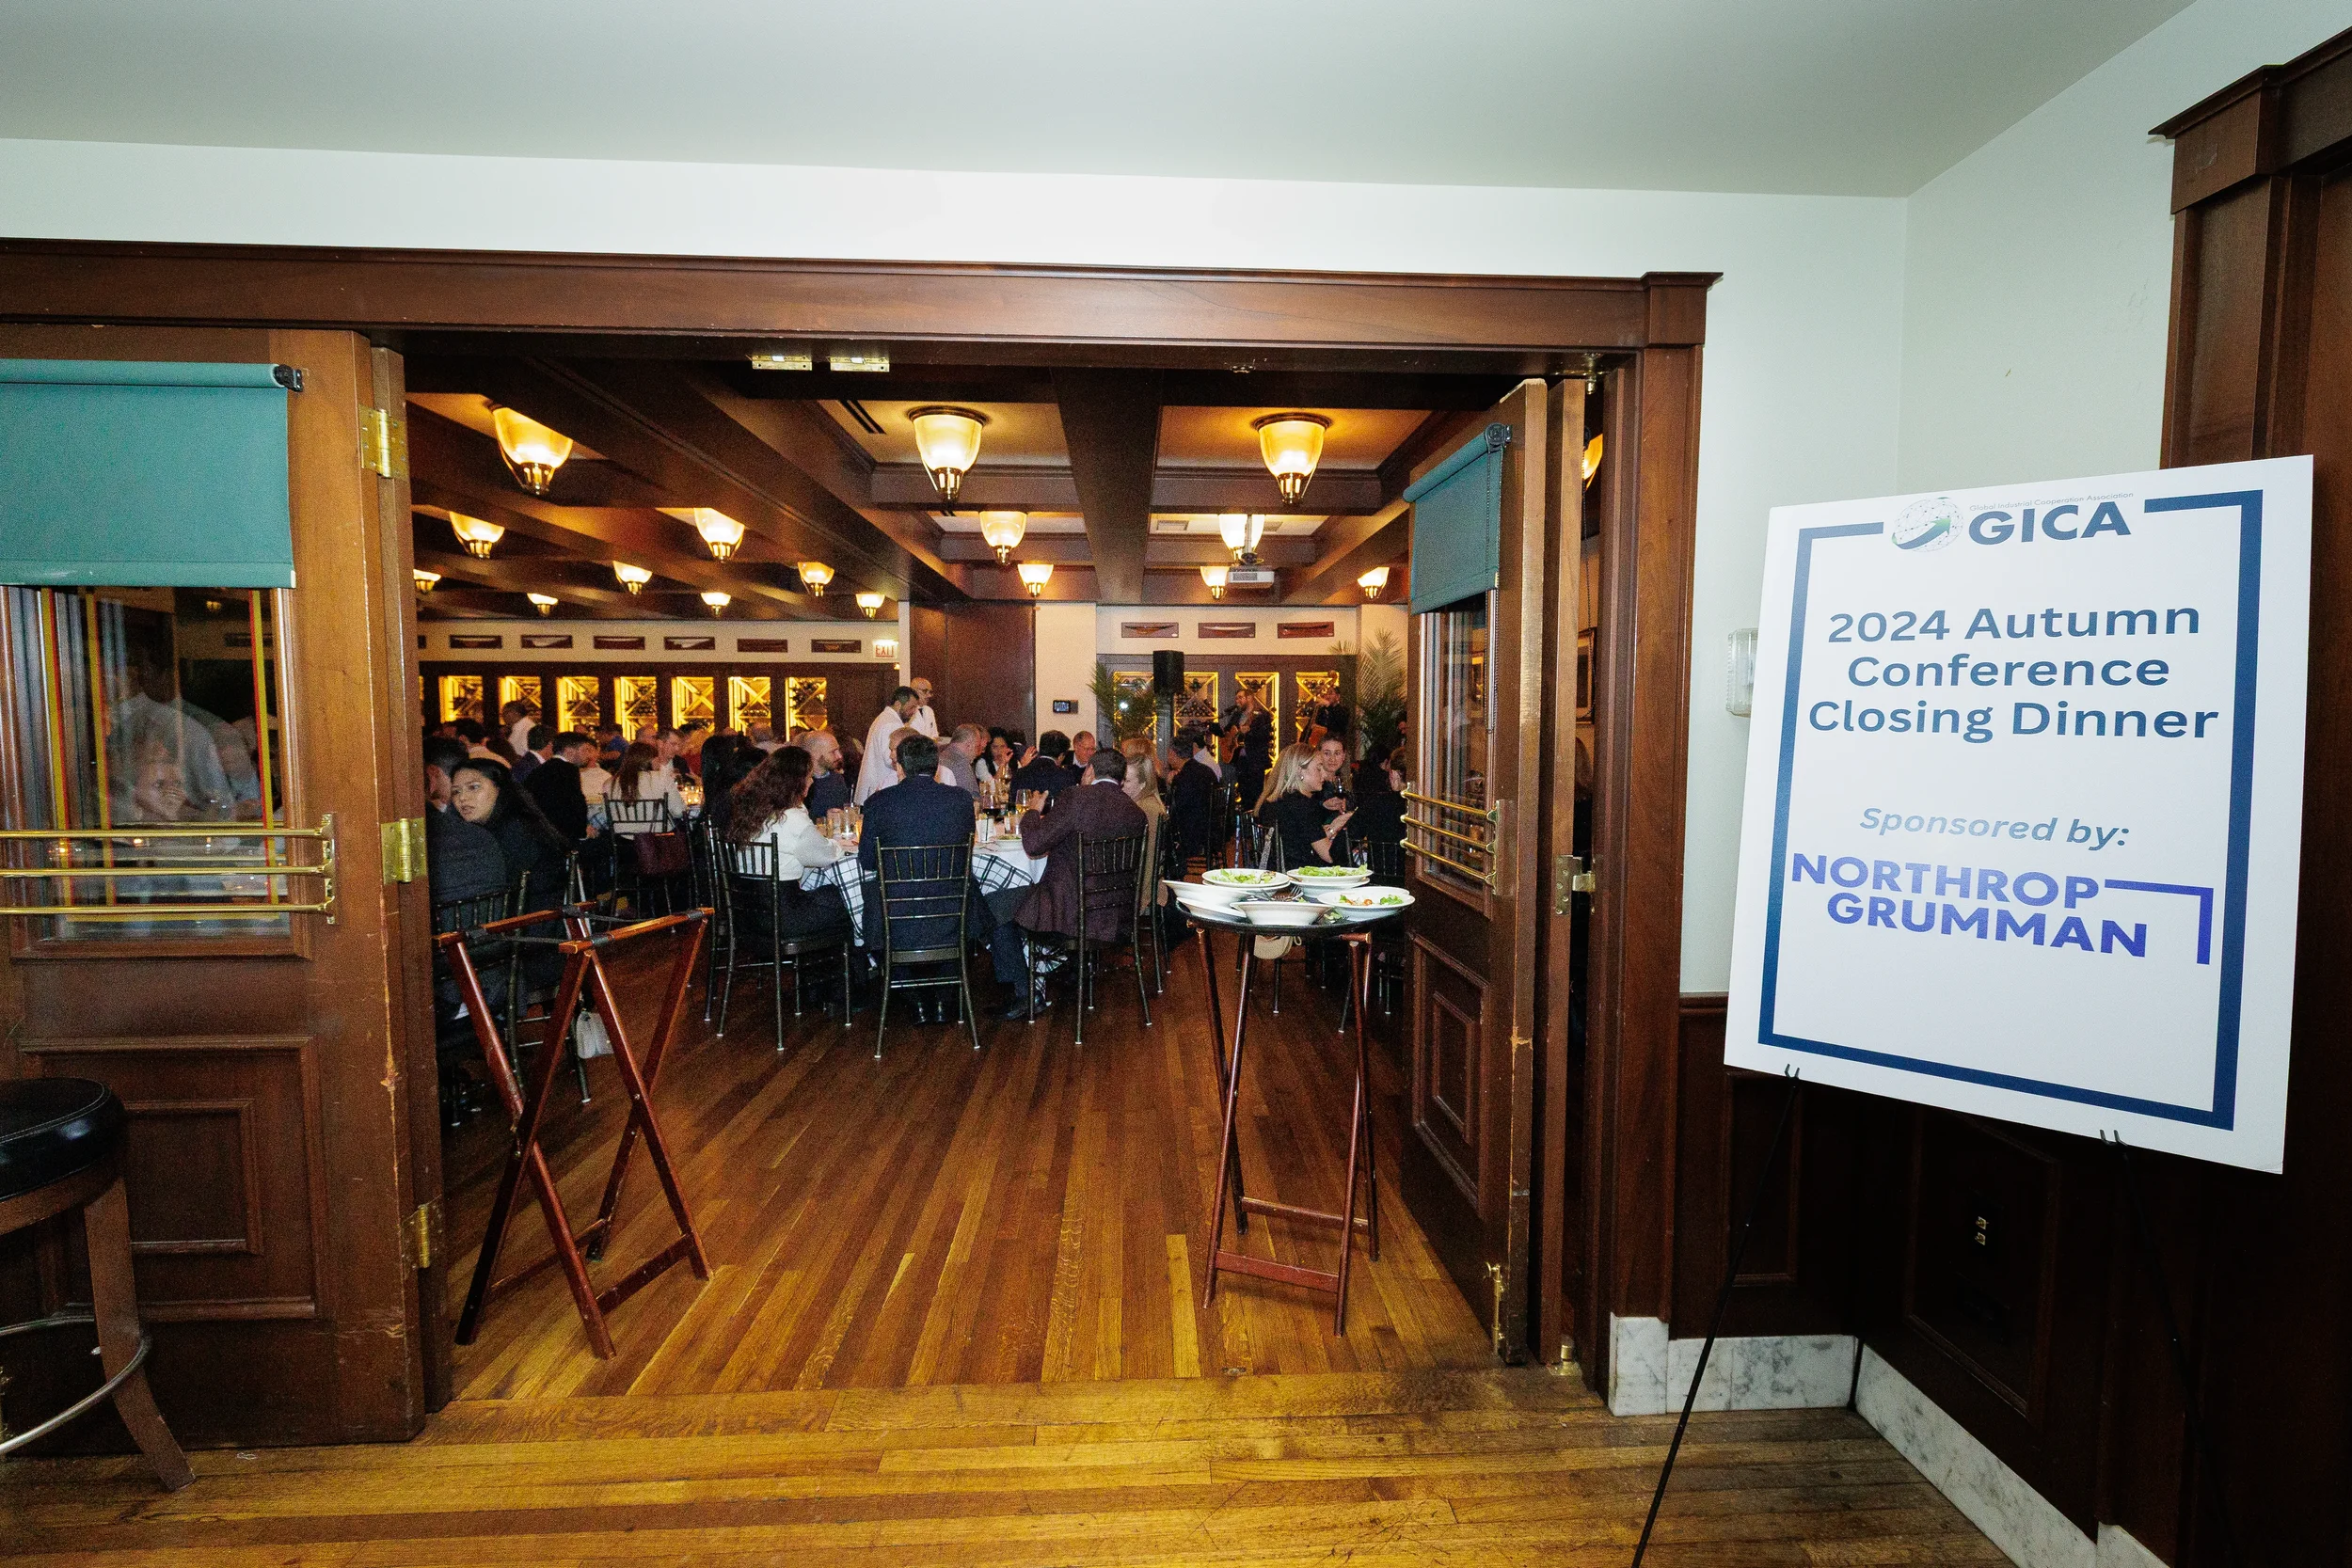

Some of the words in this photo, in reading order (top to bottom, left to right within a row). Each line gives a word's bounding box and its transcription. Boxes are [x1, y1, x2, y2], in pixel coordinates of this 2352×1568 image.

[1969, 503, 1996, 512] Global
[1997, 500, 2032, 510] Industrial
[2034, 497, 2084, 506] Cooperation
[2086, 492, 2134, 501] Association
[1969, 501, 2132, 546] GICA
[1828, 610, 1950, 643] 2024
[1964, 607, 2200, 640] Autumn
[1848, 654, 2169, 688] Conference
[1809, 699, 1994, 744] Closing
[2011, 701, 2220, 739] Dinner
[1859, 807, 2058, 842] Sponsored
[2066, 818, 2130, 851] by:
[1791, 852, 2100, 910] NORTHROP
[1827, 892, 2148, 958] GRUMMAN
